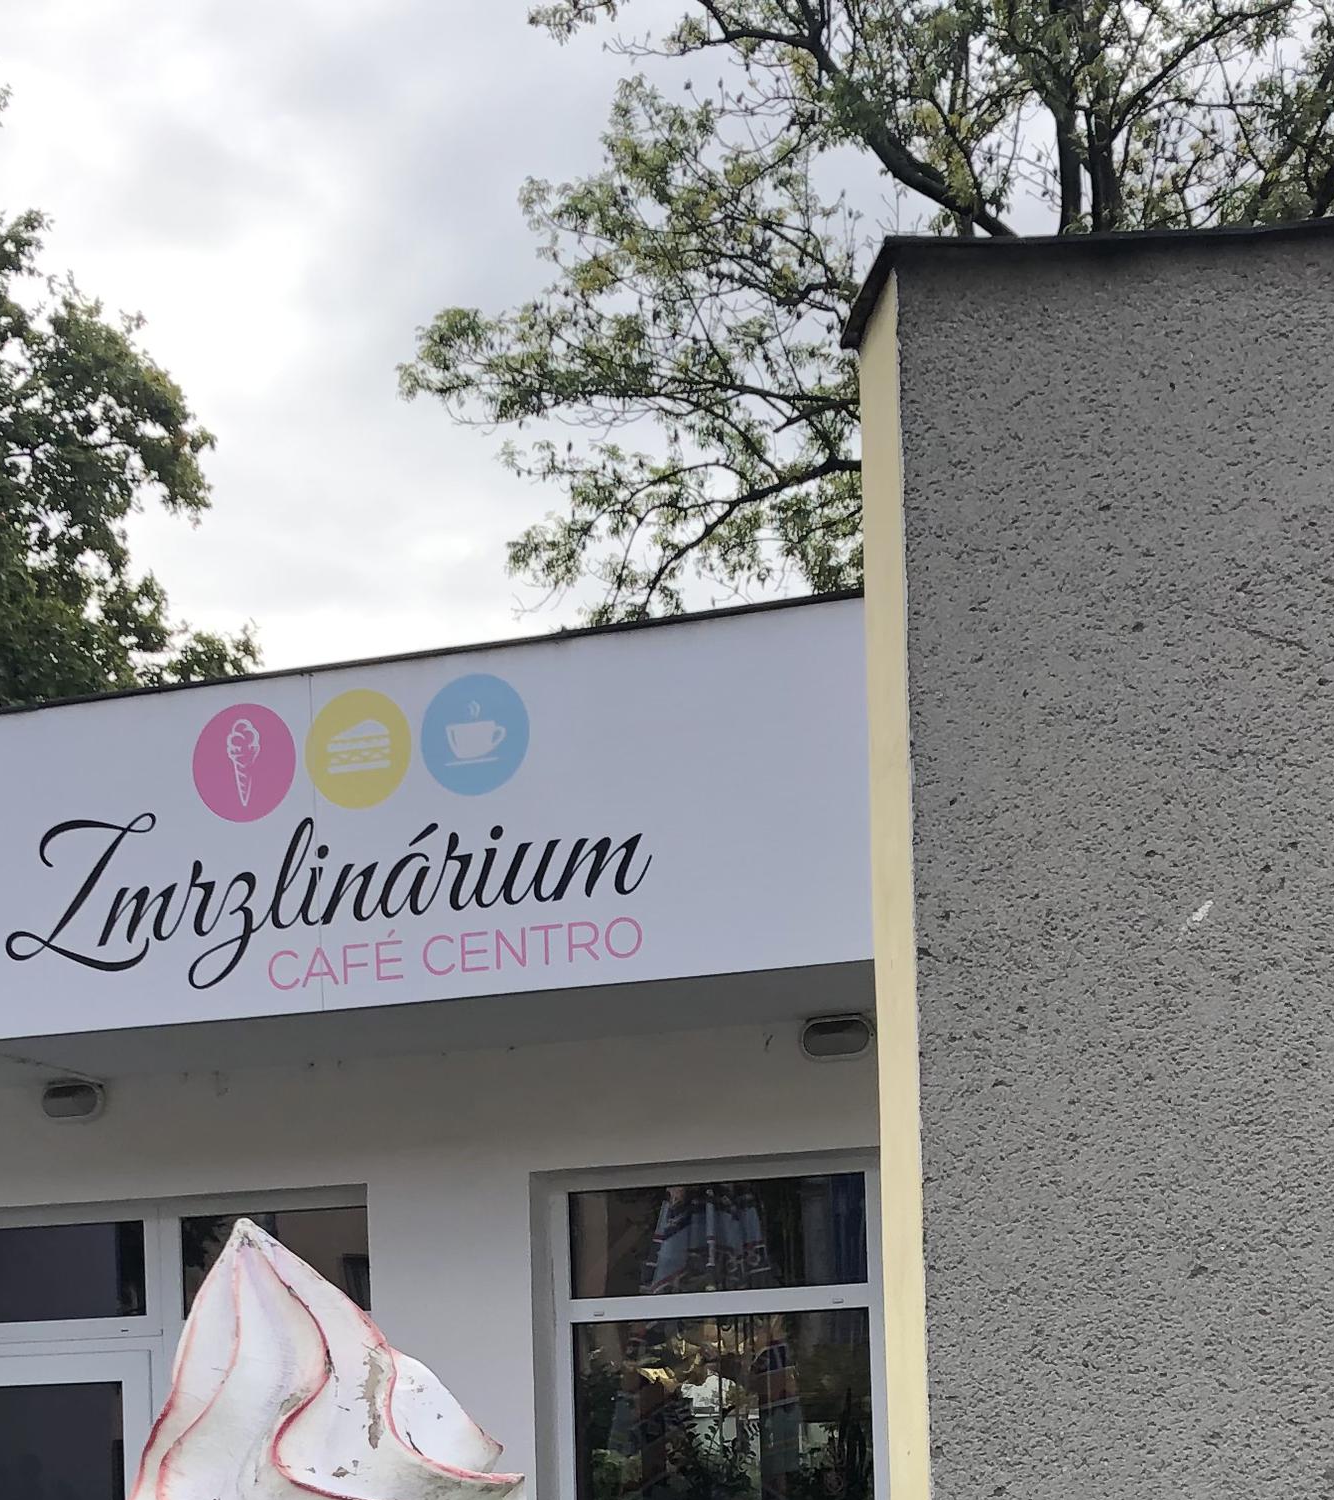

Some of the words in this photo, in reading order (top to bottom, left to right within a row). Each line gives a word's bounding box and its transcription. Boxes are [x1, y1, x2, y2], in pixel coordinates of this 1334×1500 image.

[5, 812, 652, 989] Zmrzlinárium
[267, 929, 405, 990] CAFÉ
[422, 916, 643, 974] CENTRO
